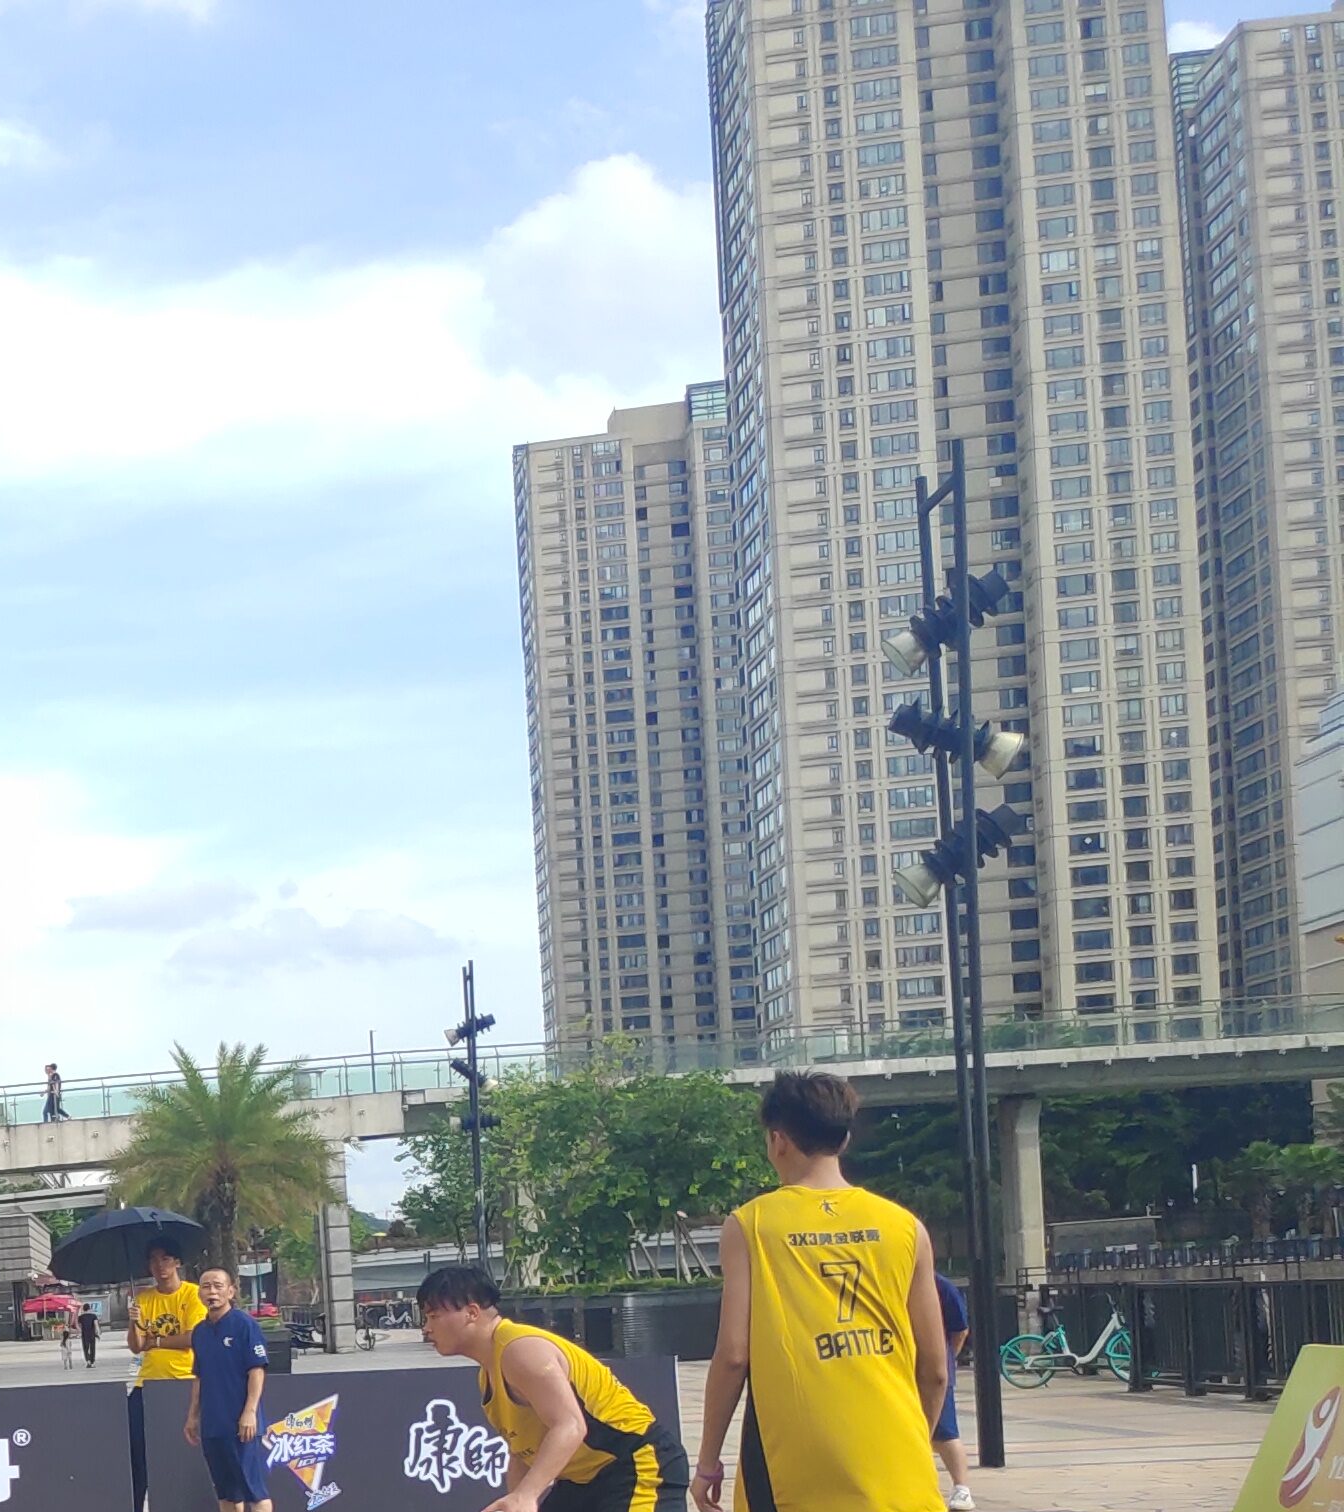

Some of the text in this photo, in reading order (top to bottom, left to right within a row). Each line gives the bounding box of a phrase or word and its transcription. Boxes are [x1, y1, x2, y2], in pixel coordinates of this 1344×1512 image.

[819, 1259, 861, 1324] 7
[815, 1327, 894, 1361] BATTLE
[267, 1432, 335, 1469] 冰红茶
